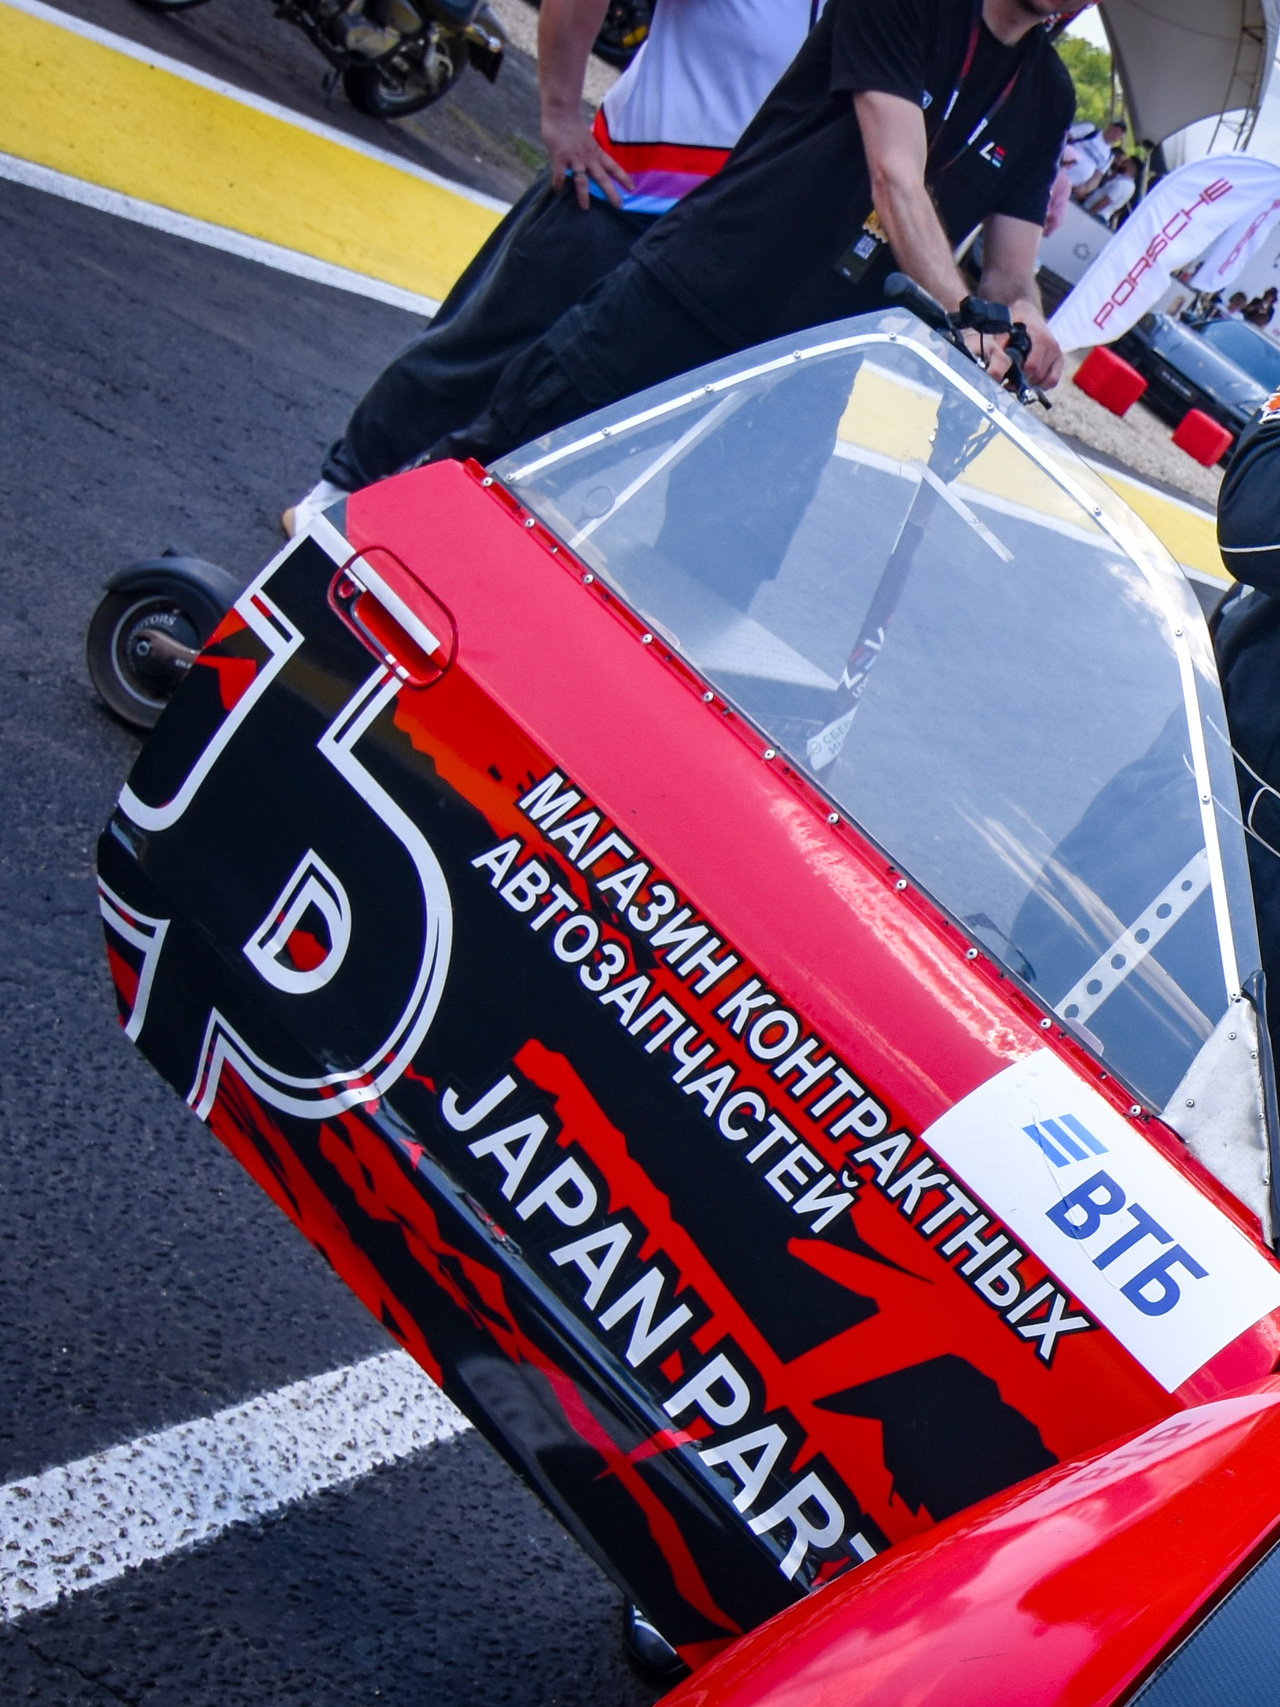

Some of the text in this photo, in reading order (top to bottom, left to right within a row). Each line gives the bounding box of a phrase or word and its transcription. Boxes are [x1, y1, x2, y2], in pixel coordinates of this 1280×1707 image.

[1093, 178, 1233, 329] PORSCHE
[471, 839, 859, 1234] АВТОЗАПЧАСТЕЙ
[519, 772, 1091, 1360] МАГАЗИН КОНТРАКТНЫХ
[442, 1074, 693, 1367] JAPAN
[1045, 1169, 1210, 1316] ВТБ
